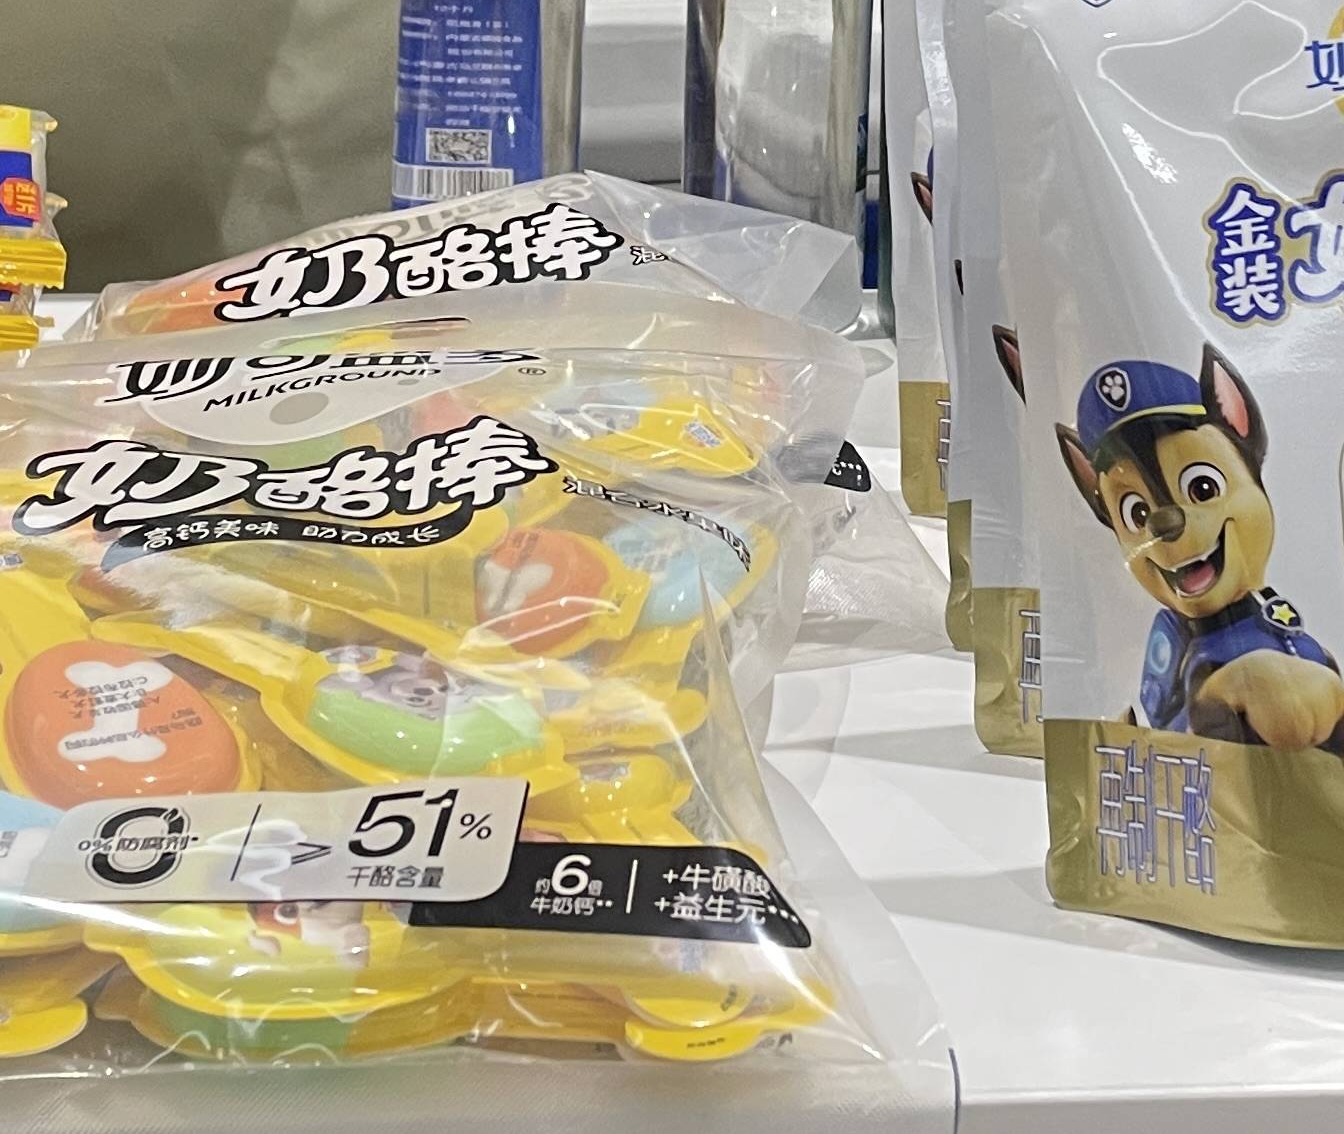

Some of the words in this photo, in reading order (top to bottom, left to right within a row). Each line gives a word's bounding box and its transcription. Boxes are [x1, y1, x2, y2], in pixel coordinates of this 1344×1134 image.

[216, 202, 626, 325] 奶酪棒
[1214, 186, 1282, 318] 金装
[202, 368, 443, 413] MILKGROUND
[12, 415, 560, 535] 奶酪棒
[141, 521, 282, 550] 高钙美味
[301, 521, 442, 548] 助力成长
[1094, 739, 1218, 896] 再制干酪
[346, 866, 445, 890] 干酪含量
